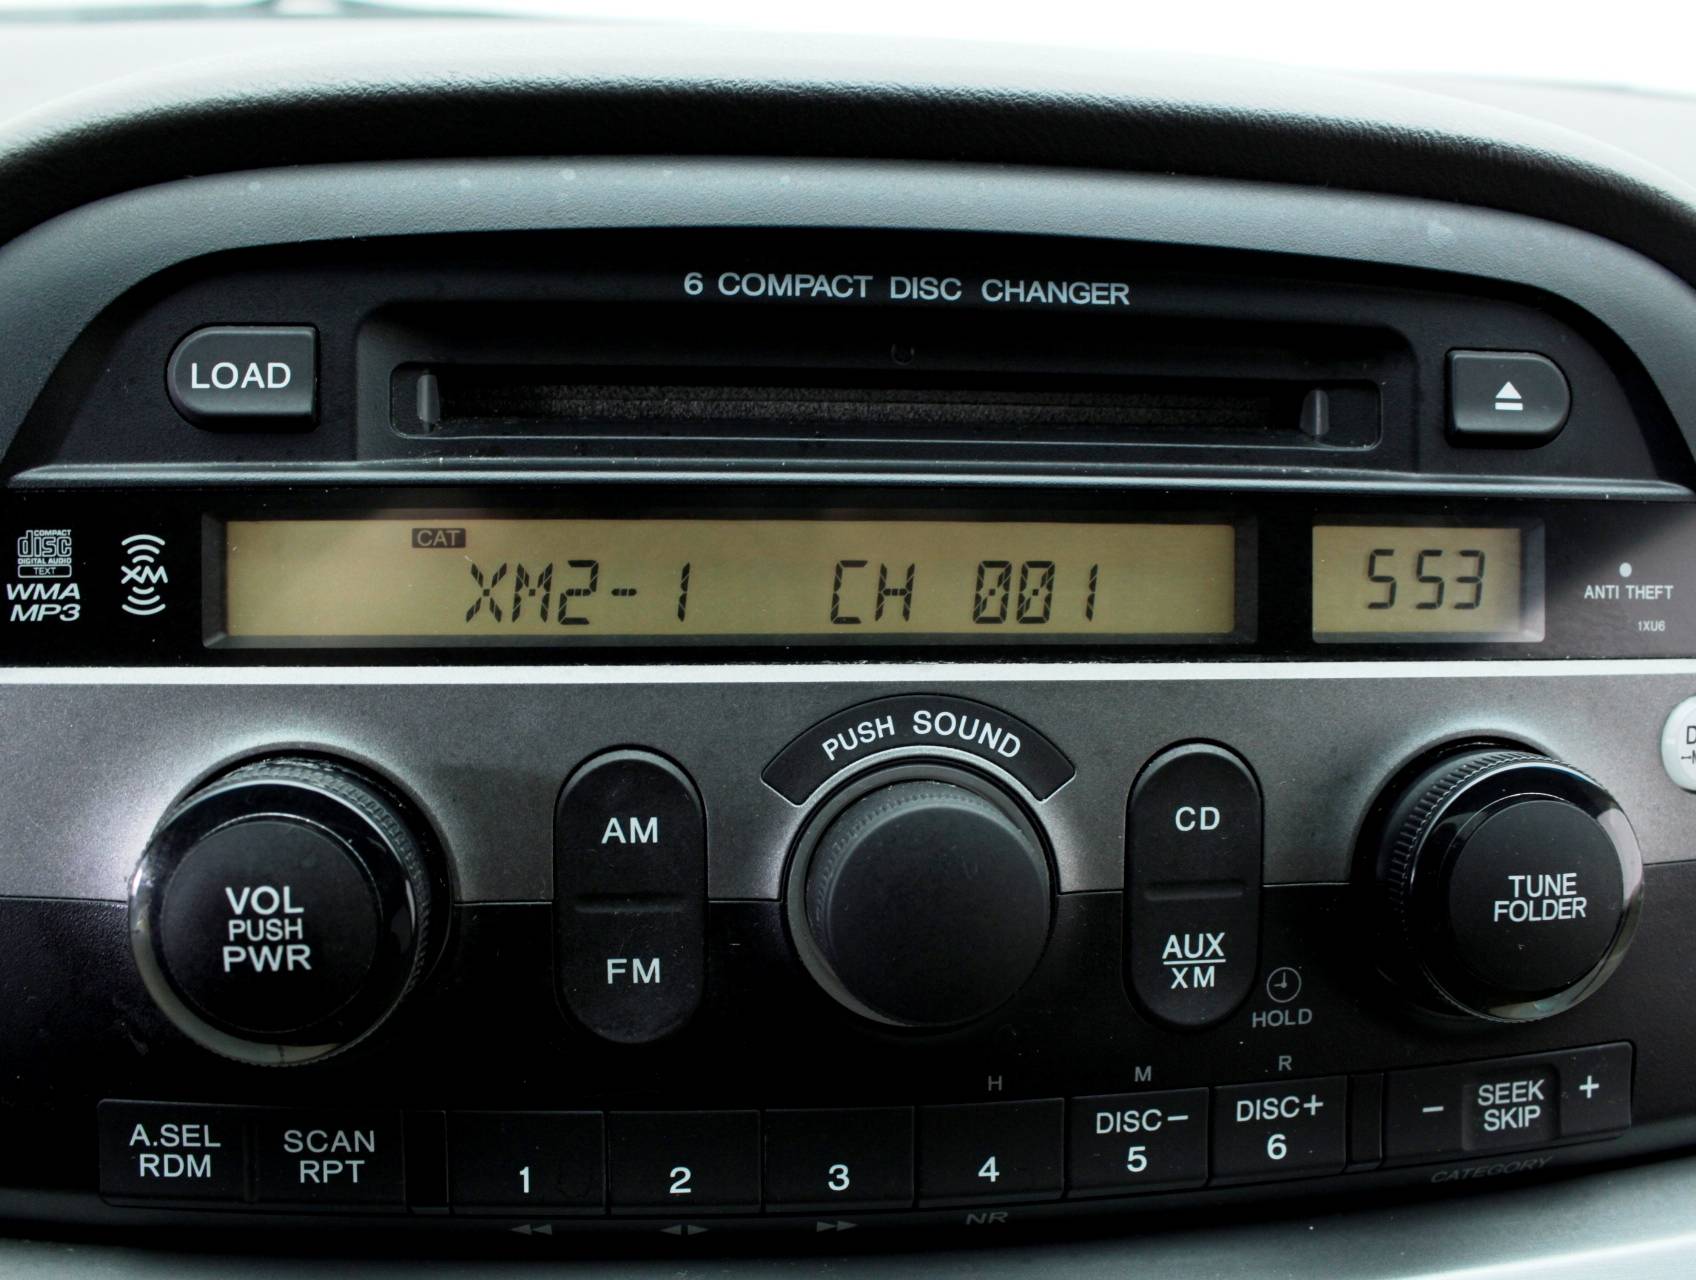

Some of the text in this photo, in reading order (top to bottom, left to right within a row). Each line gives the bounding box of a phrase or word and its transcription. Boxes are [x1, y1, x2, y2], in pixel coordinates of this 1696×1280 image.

[683, 272, 1130, 306] 6 COMPACT DISC CHANGER
[191, 361, 291, 390] LOAD
[33, 529, 72, 537] COMPACT
[416, 529, 461, 547] CAT
[17, 557, 72, 566] DIGITAL AUDIO
[32, 565, 60, 577] TEXT
[120, 565, 169, 585] XM
[6, 582, 81, 601] WMA
[830, 559, 916, 625] CH
[972, 560, 1099, 625] 001
[1583, 584, 1674, 600] ANTI THEFT
[10, 603, 81, 622] MP3
[1638, 620, 1666, 632] 1XU6
[821, 710, 1021, 761] PUSH SOUND
[601, 816, 658, 844] AM
[1175, 806, 1220, 832] CD
[1508, 872, 1578, 897] TUNE
[225, 885, 304, 915] VOL
[1494, 897, 1588, 922] FOLDER
[228, 917, 303, 942] PUSH
[222, 944, 312, 972] PWR
[1161, 932, 1226, 959] AUX
[607, 957, 661, 985] FM
[1170, 965, 1215, 990] XM
[1252, 1008, 1313, 1028] HOLD
[1134, 1065, 1152, 1082] M
[1278, 1055, 1293, 1071] R
[988, 1075, 1003, 1092] H
[1477, 1079, 1545, 1106] SEEK
[1483, 1106, 1542, 1132] SKIP
[129, 1123, 221, 1147] A.SEL
[283, 1129, 375, 1153] SCAN
[1267, 1133, 1287, 1160] 6
[139, 1153, 211, 1178] RDM
[299, 1159, 365, 1184] RPT
[978, 1156, 1000, 1183] 4
[1127, 1146, 1148, 1173] 5
[1430, 1156, 1553, 1183] CATEGORY
[519, 1166, 530, 1194] 1
[669, 1166, 692, 1194] 2
[828, 1164, 850, 1191] 3
[966, 1210, 1009, 1225] NR
